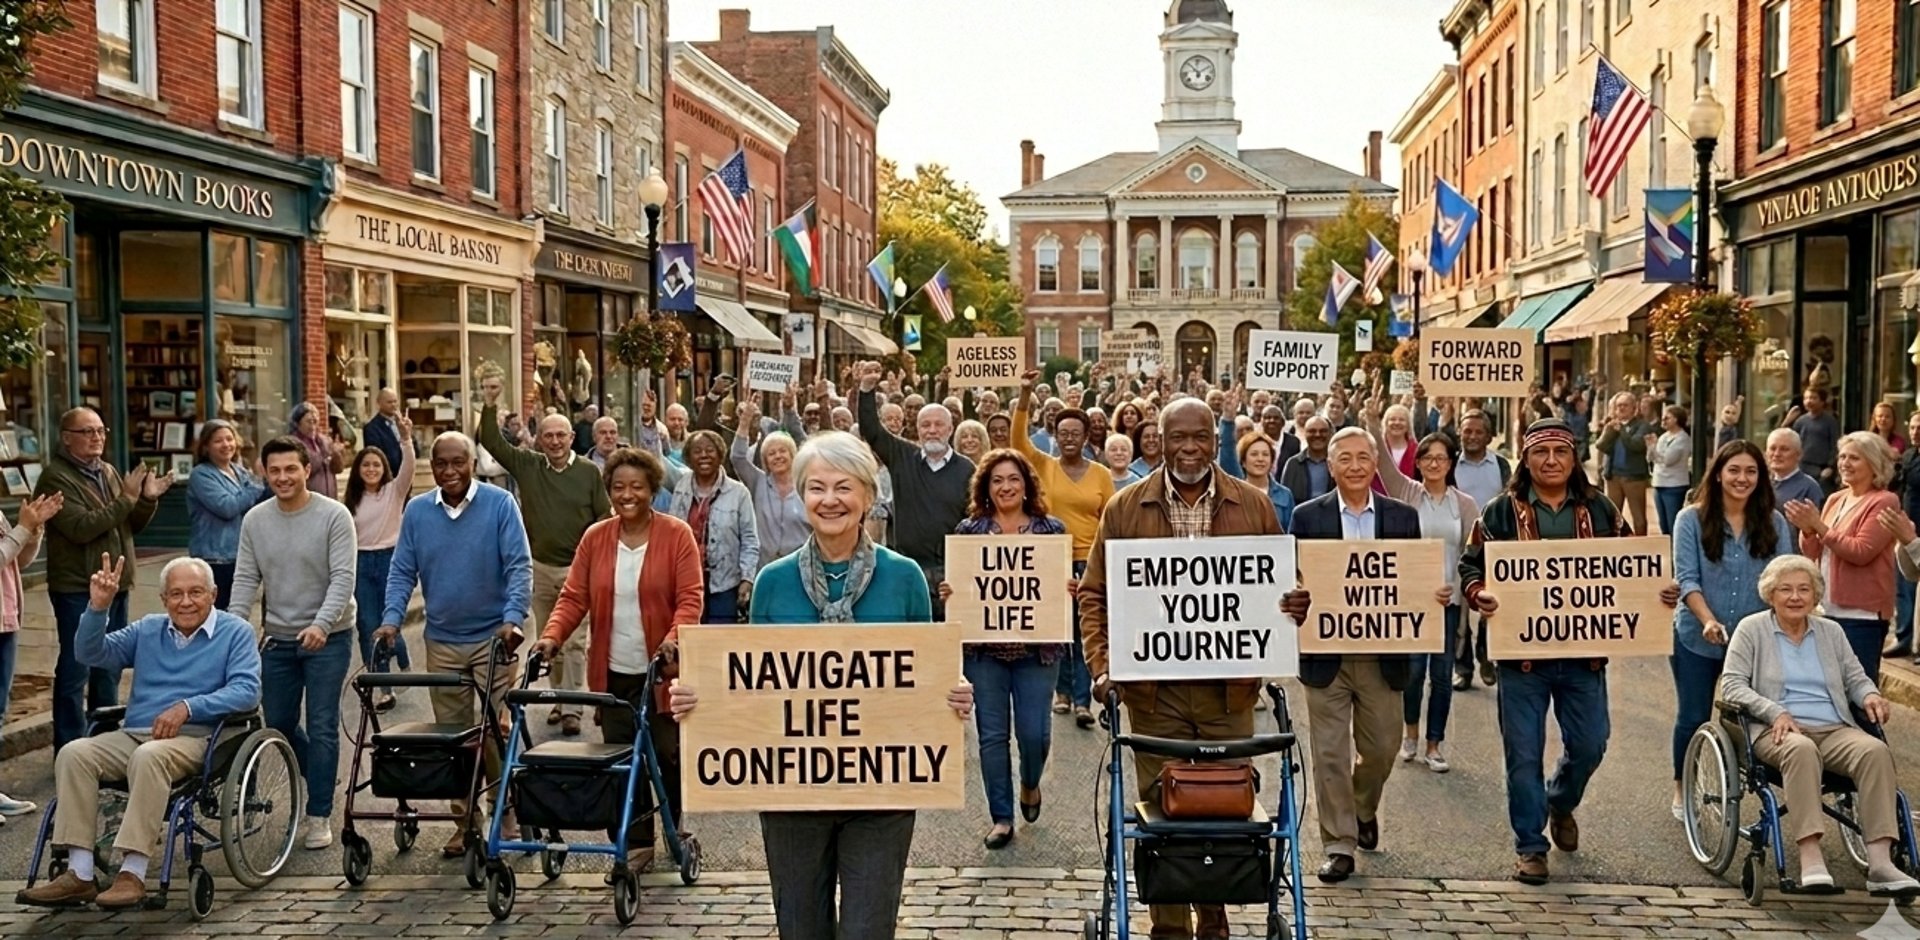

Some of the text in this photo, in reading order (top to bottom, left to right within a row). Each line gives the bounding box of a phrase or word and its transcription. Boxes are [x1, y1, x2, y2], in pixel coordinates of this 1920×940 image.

[0, 133, 273, 219] DOWNTOWN BOOKS
[1826, 154, 1918, 209] ANTIQUES
[356, 214, 391, 244] THE
[396, 222, 446, 255] LOCAL
[956, 346, 1017, 361] AGELESS
[1263, 340, 1323, 359] FAMILY
[1431, 340, 1522, 359] FORWARD
[955, 363, 1018, 378] JOURNEY
[1253, 360, 1330, 380] SUPPORT
[1428, 362, 1524, 381] TOGETHER
[981, 546, 1035, 571] LIVE
[1126, 554, 1276, 587] EMPOWER
[1345, 551, 1398, 579] AGE
[1494, 554, 1662, 582] OUR STRENGTH
[974, 576, 1042, 601] YOUR
[1344, 585, 1398, 607] WITH
[1542, 585, 1616, 610] IS OUR
[984, 606, 1035, 630] LIFE
[1161, 592, 1241, 624] YOUR
[1318, 612, 1426, 639] DIGNITY
[1519, 613, 1640, 643] JOURNEY
[1133, 628, 1272, 662] JOURNEY
[728, 650, 916, 690] NAVIGATE
[784, 699, 861, 737] LIFE
[697, 745, 949, 786] CONFIDENTLY
